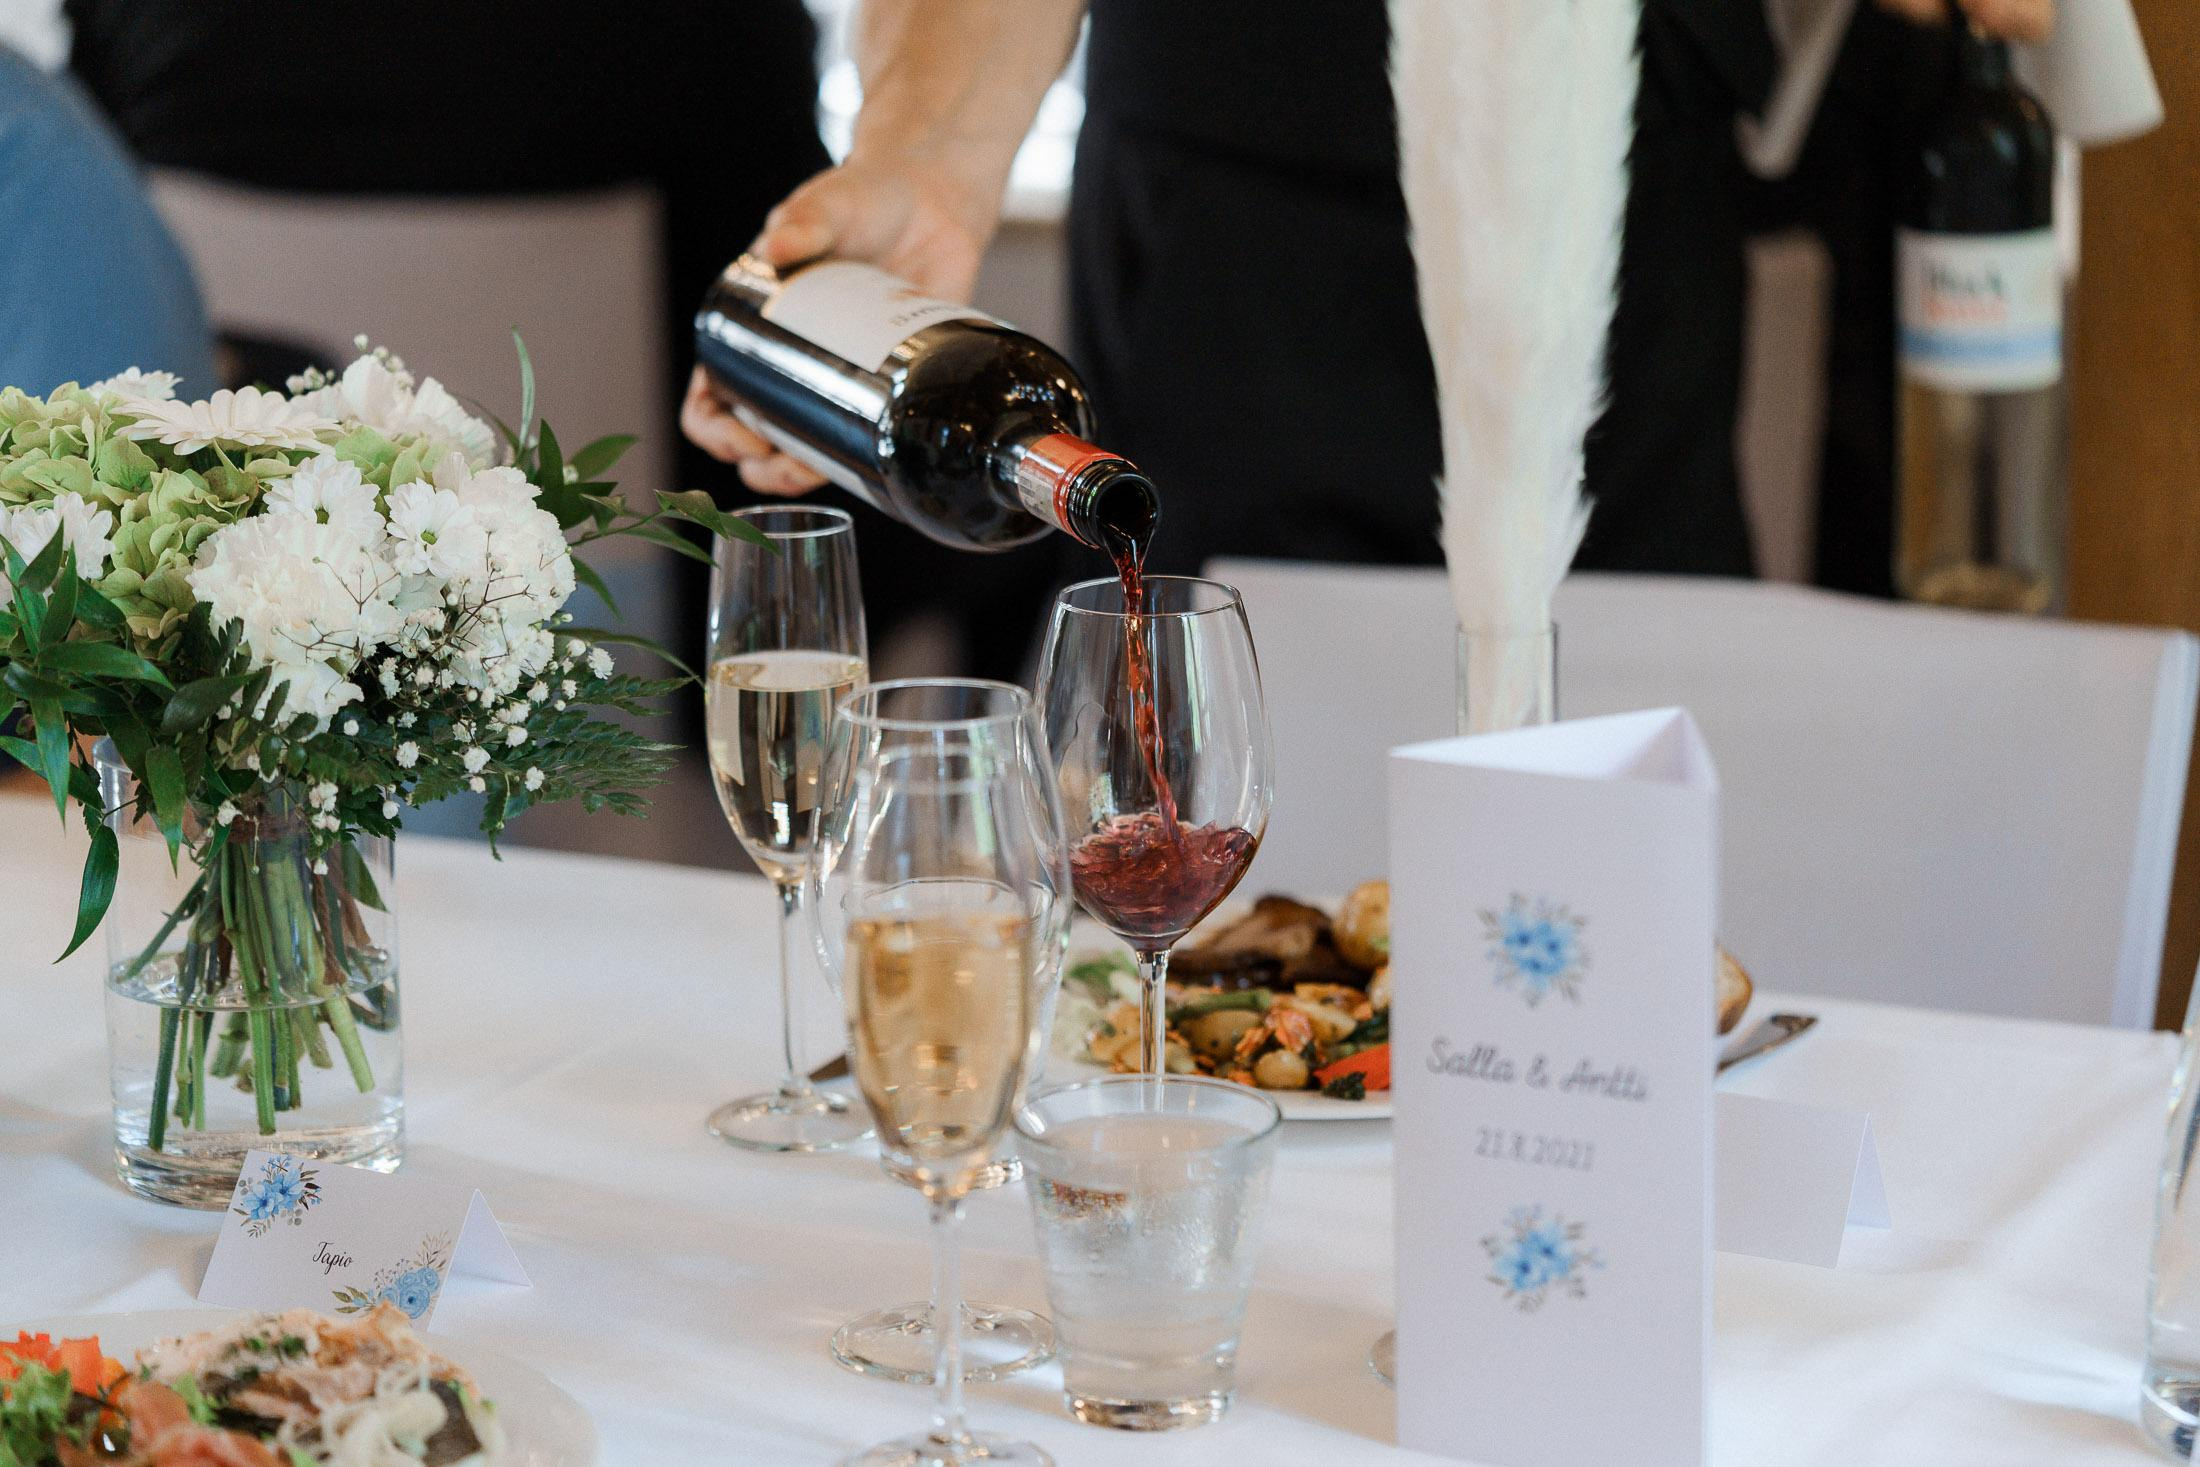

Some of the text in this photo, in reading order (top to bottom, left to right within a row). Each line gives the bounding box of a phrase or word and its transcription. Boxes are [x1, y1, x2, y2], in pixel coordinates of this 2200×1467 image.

[1426, 1037, 1649, 1100] Salla & Antti
[312, 1241, 353, 1275] Tapio
